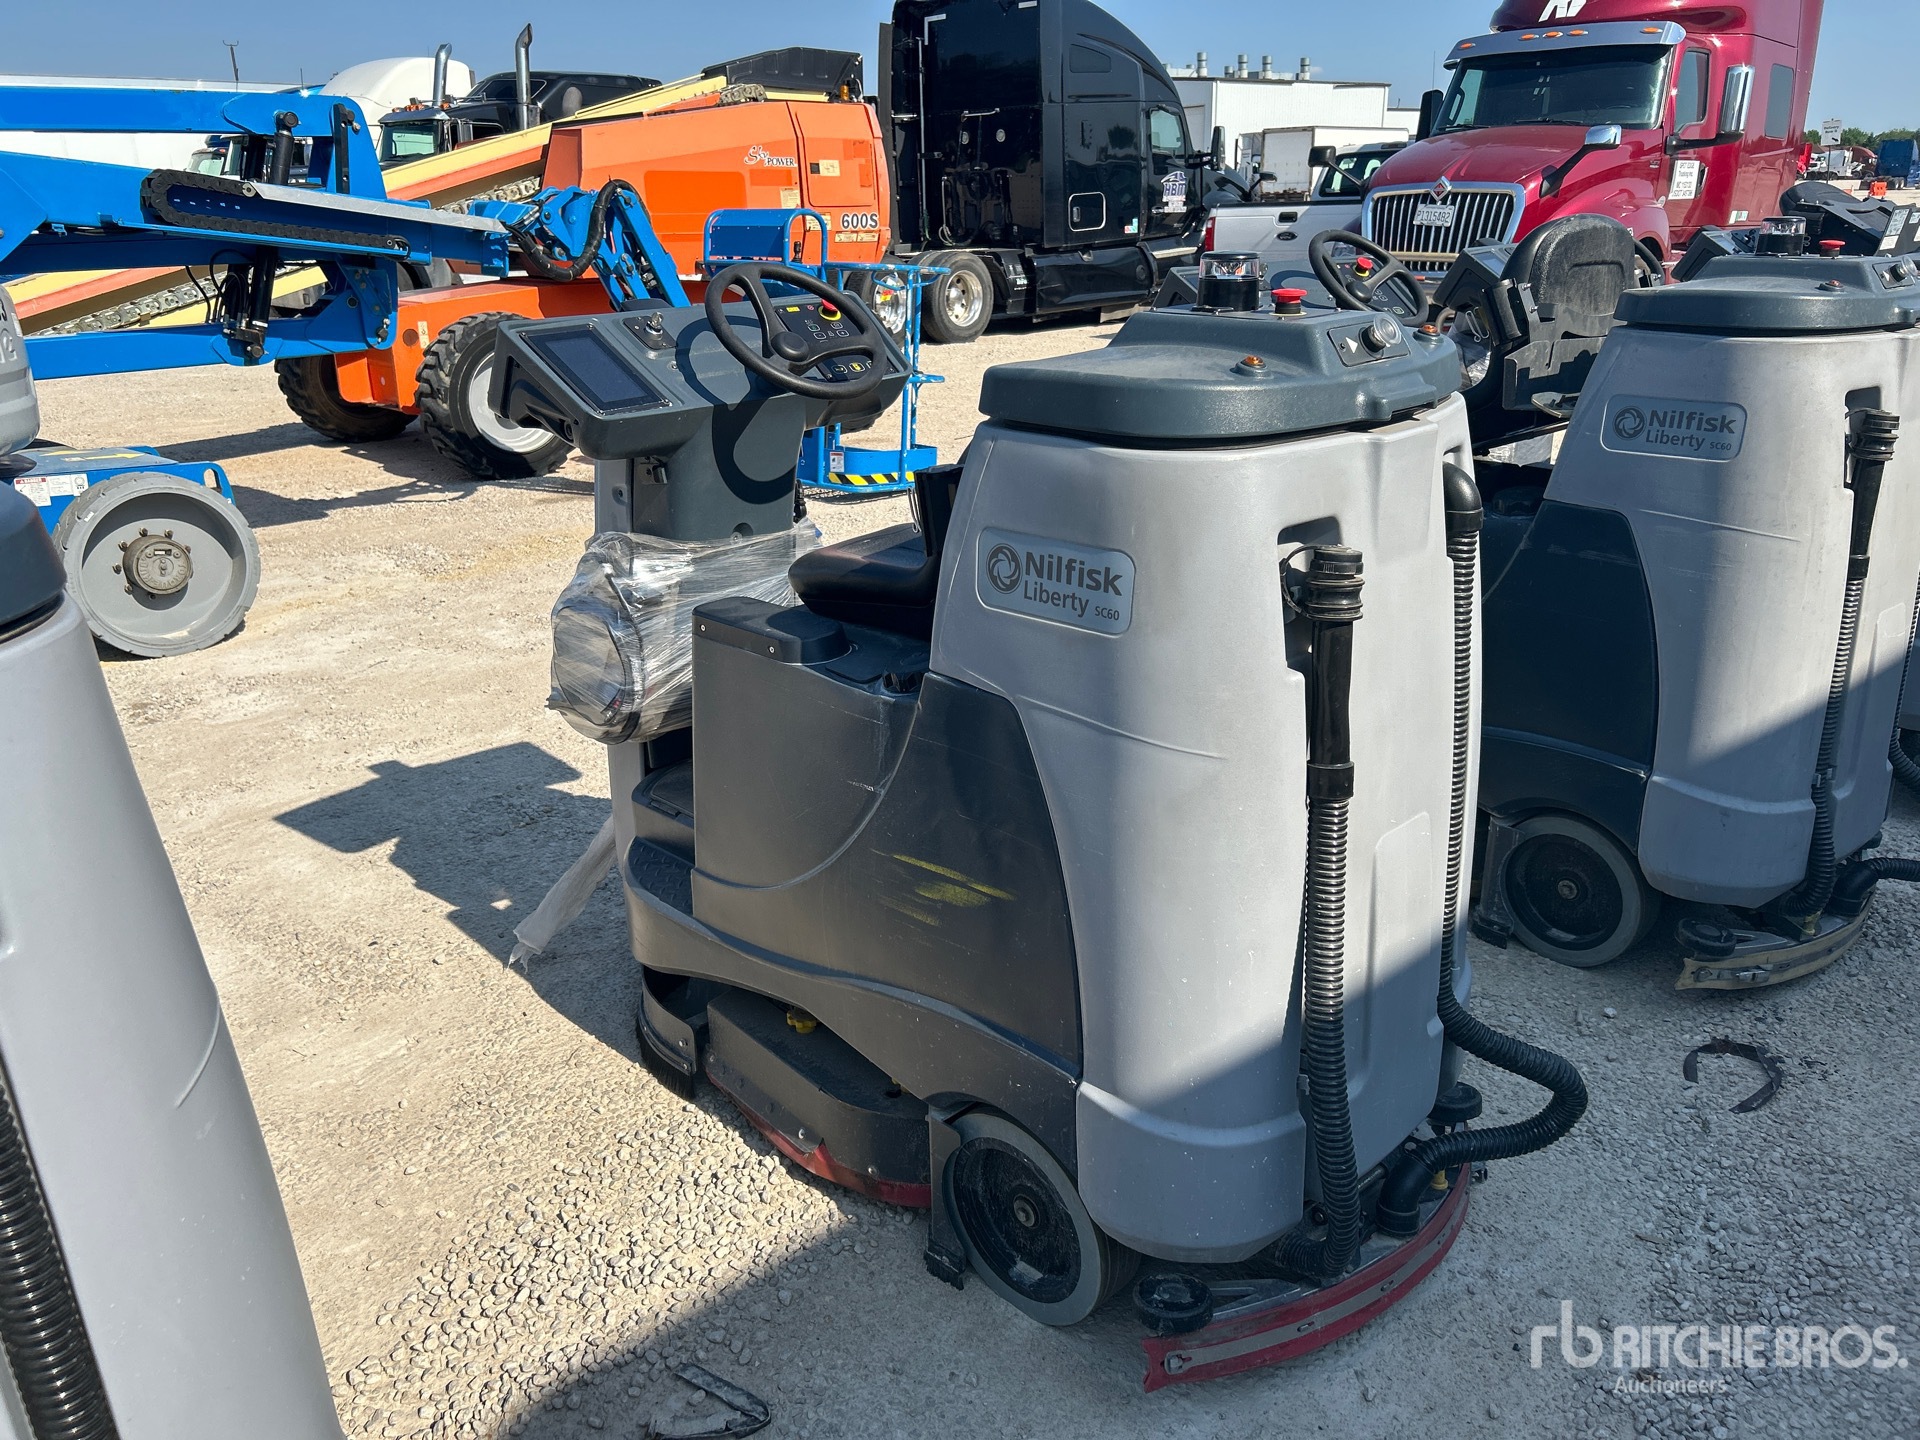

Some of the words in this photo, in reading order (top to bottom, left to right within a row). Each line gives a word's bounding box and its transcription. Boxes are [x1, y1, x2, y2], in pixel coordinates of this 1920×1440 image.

[765, 157, 798, 167] POWER
[841, 212, 878, 230] 600S
[1648, 409, 1737, 434] Nilfisk
[1645, 429, 1706, 451] Liberty
[1709, 441, 1732, 451] SC60
[1025, 551, 1123, 596] Nilfisk
[1023, 580, 1089, 618] Liberty
[1094, 605, 1120, 621] SC60
